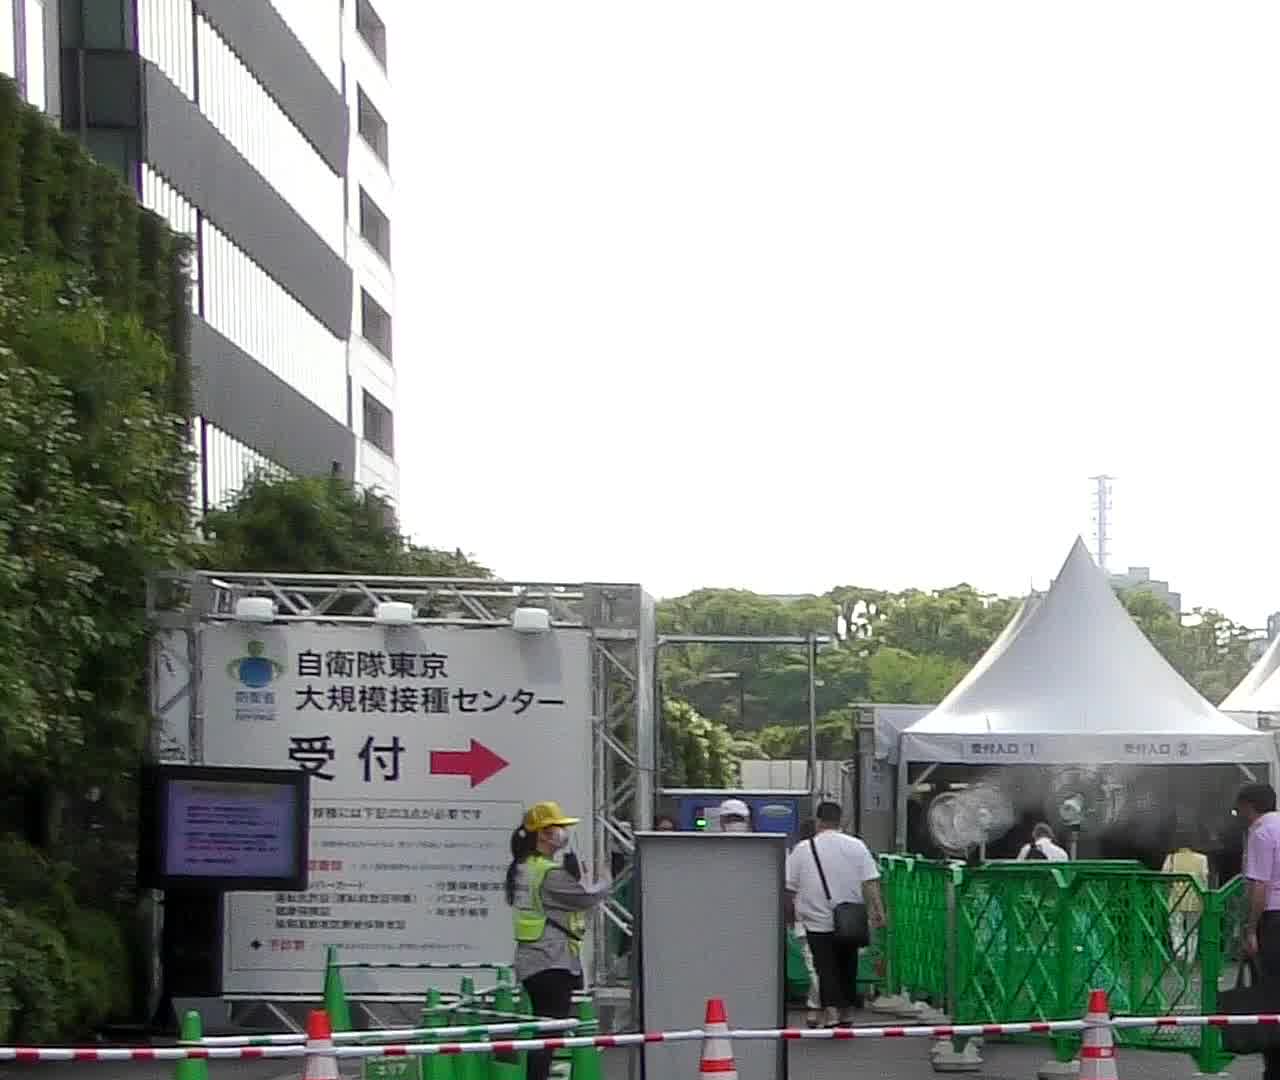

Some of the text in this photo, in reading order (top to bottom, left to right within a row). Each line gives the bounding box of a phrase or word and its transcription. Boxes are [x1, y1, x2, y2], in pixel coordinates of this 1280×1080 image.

[297, 651, 449, 679] 自衛隊東京
[295, 684, 565, 715] 大規模接種センター
[288, 735, 406, 783] 受付
[971, 743, 1035, 755] 受付入口 1
[1124, 743, 1190, 756] 受付入口 2
